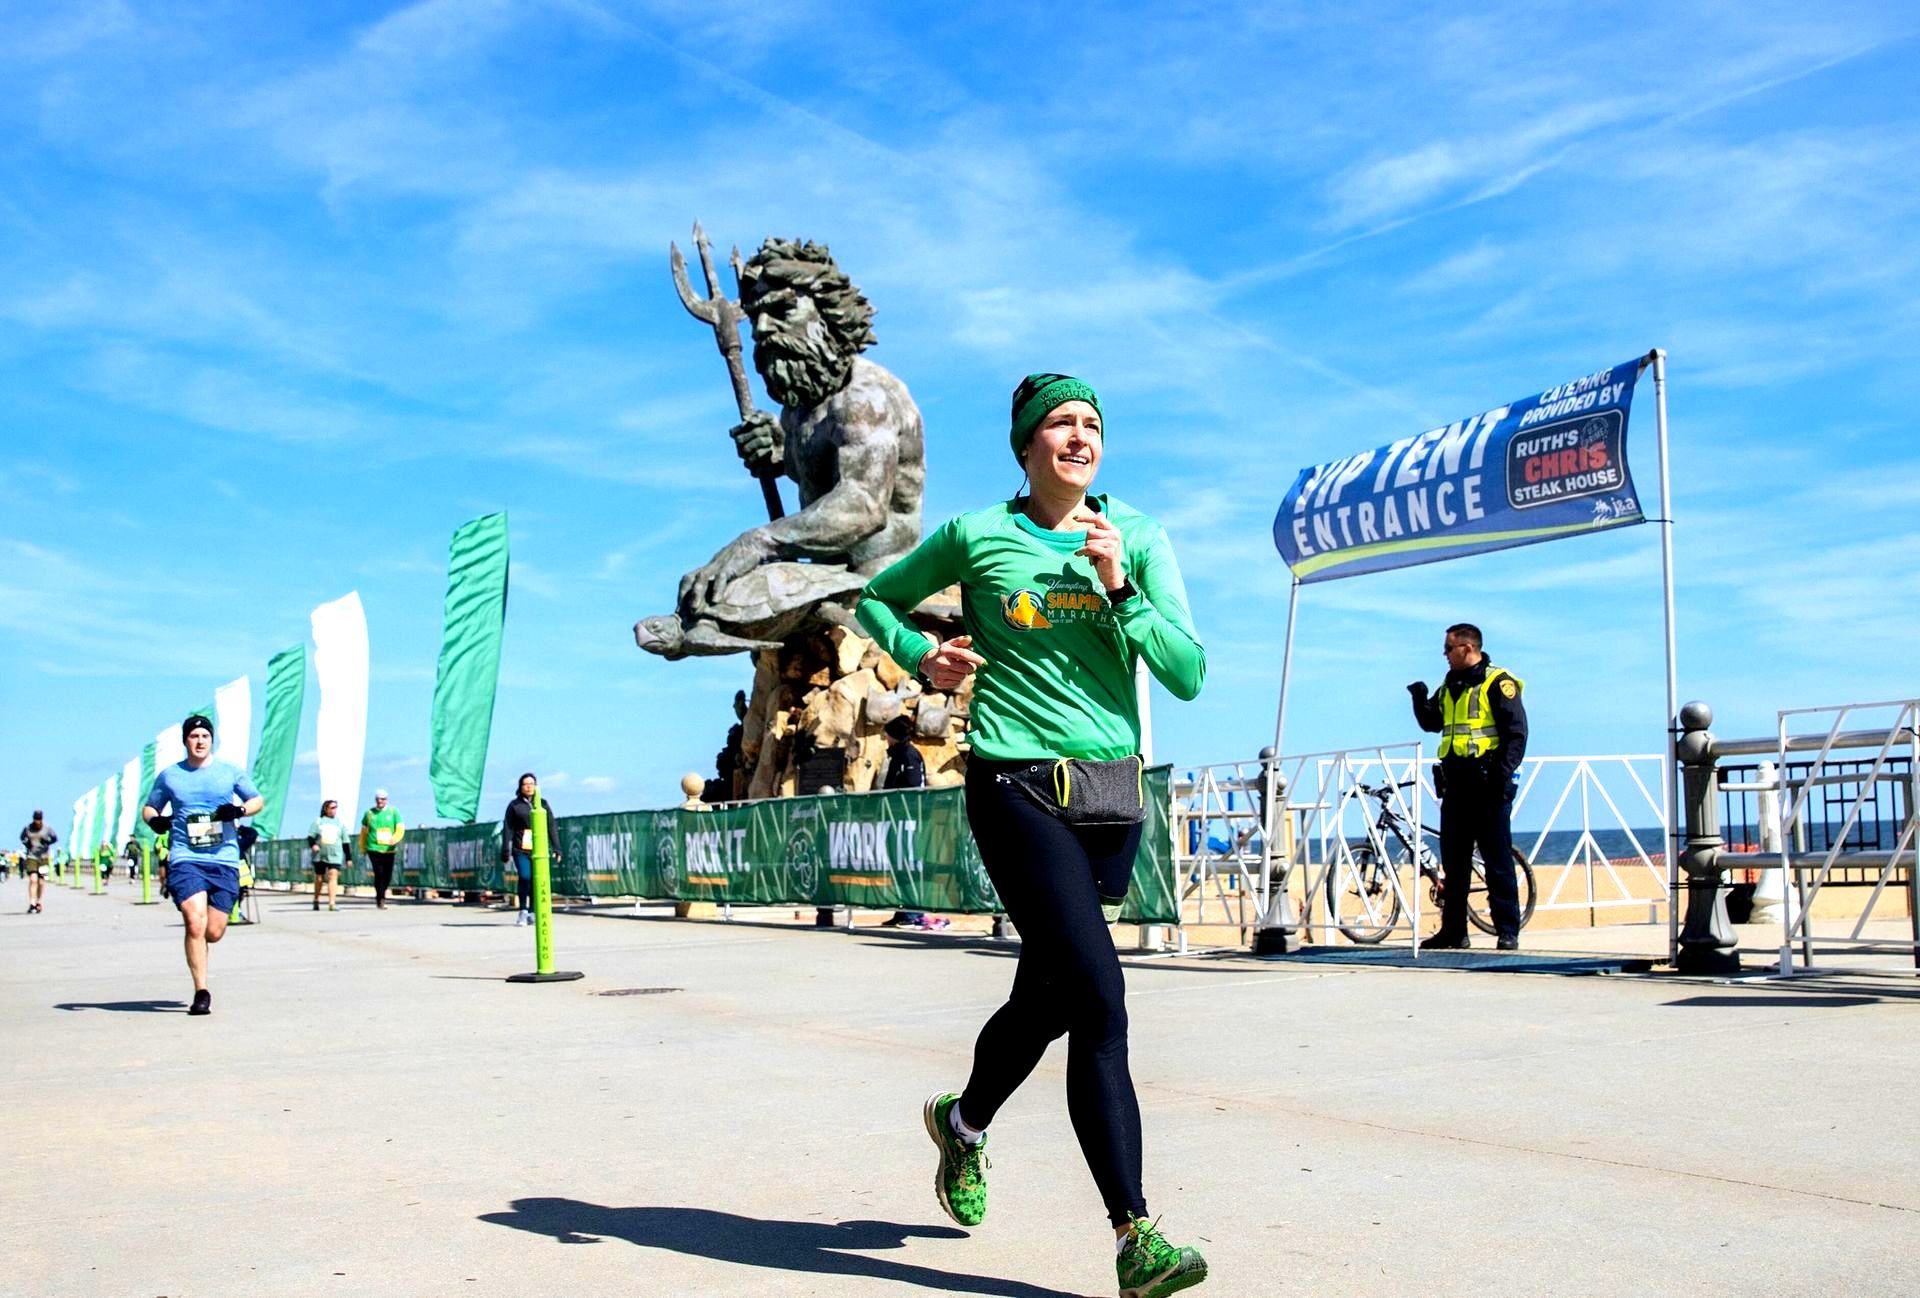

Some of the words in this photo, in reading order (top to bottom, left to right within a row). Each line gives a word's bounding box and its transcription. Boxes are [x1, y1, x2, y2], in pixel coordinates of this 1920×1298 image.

[1519, 390, 1598, 427] PROVIDED
[1599, 382, 1626, 405] BY
[1539, 367, 1613, 405] CATERING
[1294, 449, 1376, 514] VIP
[1373, 403, 1512, 494] TENT
[1516, 430, 1579, 459] RUTH'S
[1525, 442, 1607, 484] CHRIS
[1514, 480, 1562, 502] STEAK
[1565, 468, 1618, 492] HOUSE
[1293, 474, 1485, 557] ENTRANCE
[1610, 497, 1637, 517] j&a
[1047, 609, 1116, 625] MARATHO
[685, 831, 724, 873] ROCK
[724, 829, 751, 872] IT.
[829, 820, 891, 871] WORK
[896, 820, 923, 872] IT.
[541, 913, 549, 960] RACING
